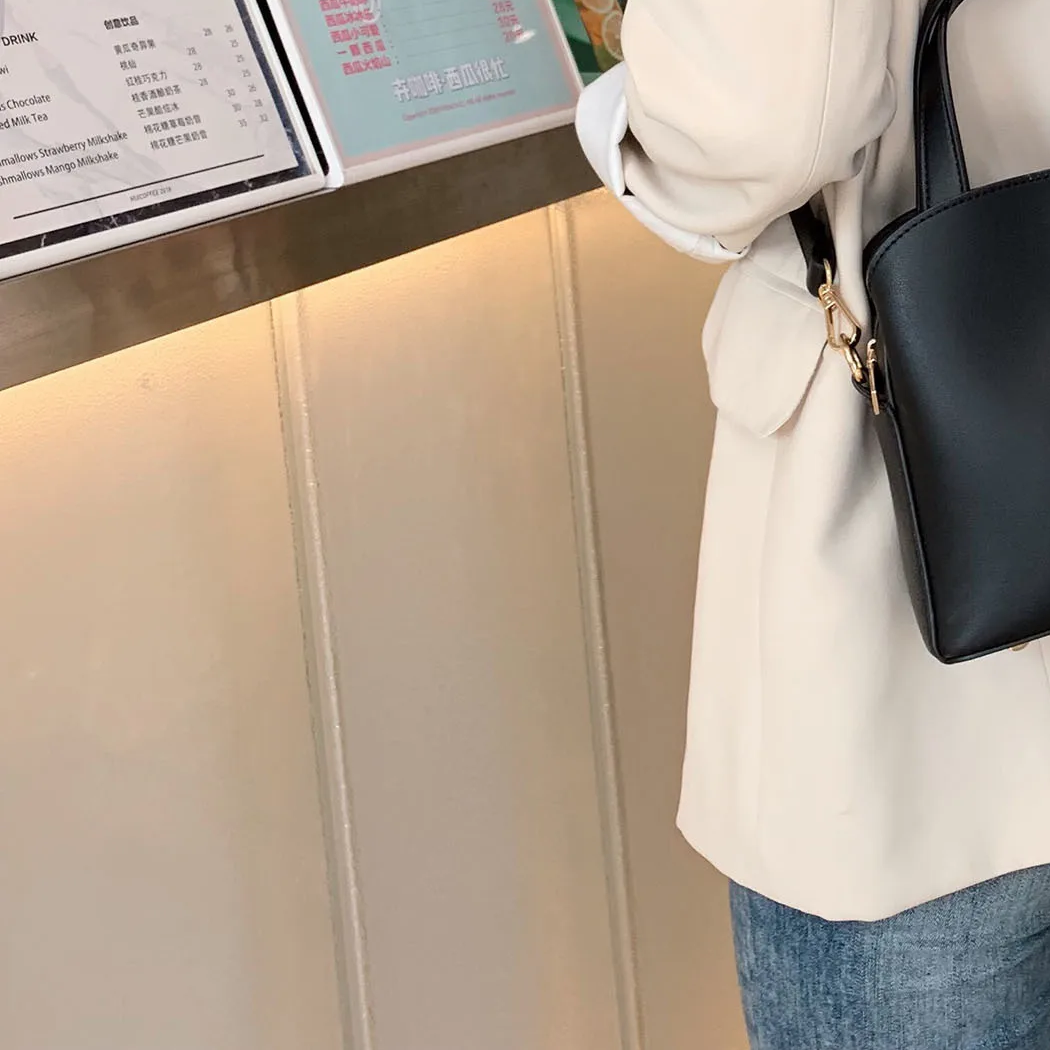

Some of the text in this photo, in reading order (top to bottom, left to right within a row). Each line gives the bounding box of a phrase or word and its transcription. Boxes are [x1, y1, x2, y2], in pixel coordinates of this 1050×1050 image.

[103, 15, 139, 31] 创意饮品
[1, 32, 39, 47] DRINK
[6, 94, 51, 110] Chocolate
[11, 115, 31, 127] Milk
[31, 112, 48, 123] Tea
[39, 141, 87, 158] Strawberry
[87, 131, 128, 147] Milkshake
[45, 162, 77, 176] Mango
[77, 151, 119, 167] Milkshake
